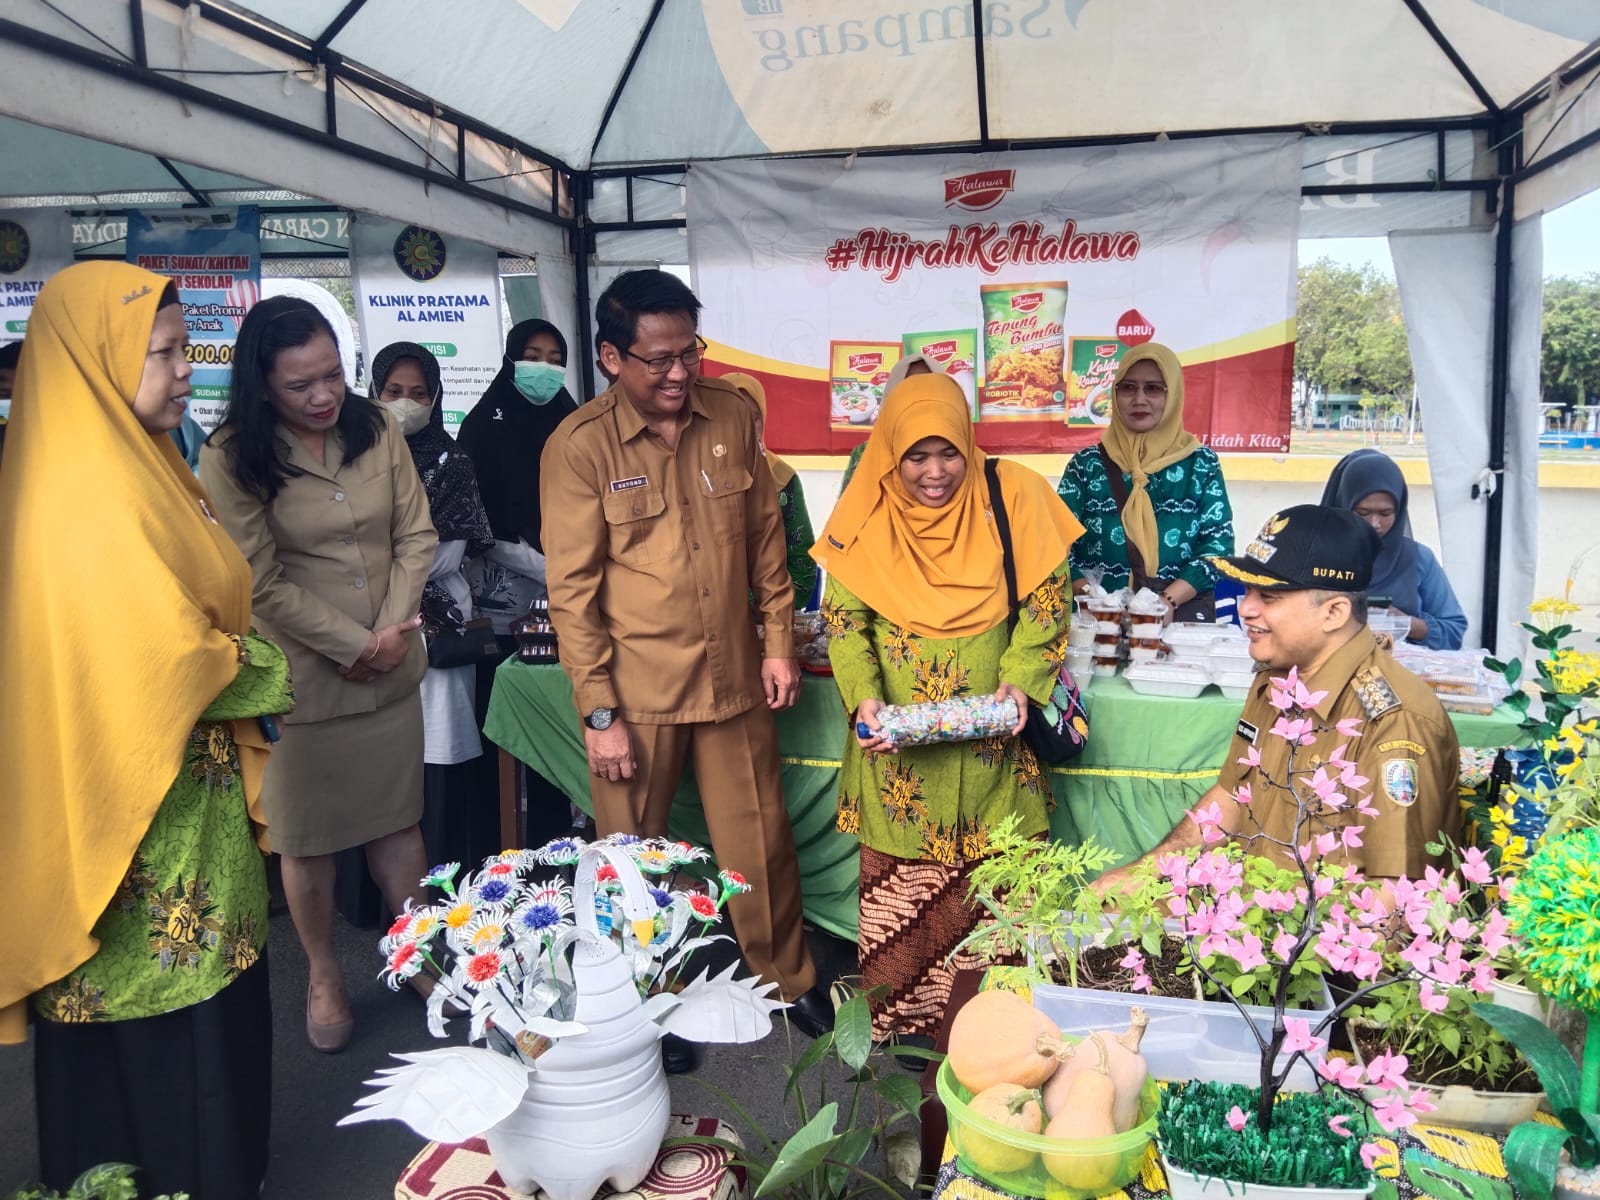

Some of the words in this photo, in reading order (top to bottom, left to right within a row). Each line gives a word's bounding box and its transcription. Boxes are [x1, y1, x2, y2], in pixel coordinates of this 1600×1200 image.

[825, 219, 1140, 283] #HijrahKeHalawa
[138, 256, 169, 270] PAKET
[171, 255, 249, 270] SUNAT/KHITAN
[185, 275, 233, 289] SEKOLAH
[368, 295, 416, 307] KLINIK
[417, 294, 490, 307] PRATAMA
[182, 304, 209, 316] Paket
[211, 304, 246, 316] Promo
[397, 310, 417, 322] AL
[418, 310, 465, 322] AMIEN
[196, 319, 222, 331] Anak
[985, 316, 1039, 337] Tepung
[1118, 325, 1152, 336] BARU!
[1010, 322, 1062, 345] Bumbu
[1086, 358, 1120, 377] Kaldu
[195, 389, 221, 397] SUDAH
[984, 389, 1020, 398] ROBIOTIK
[1202, 433, 1244, 447] Lidah
[1312, 567, 1355, 580] BUPATI
